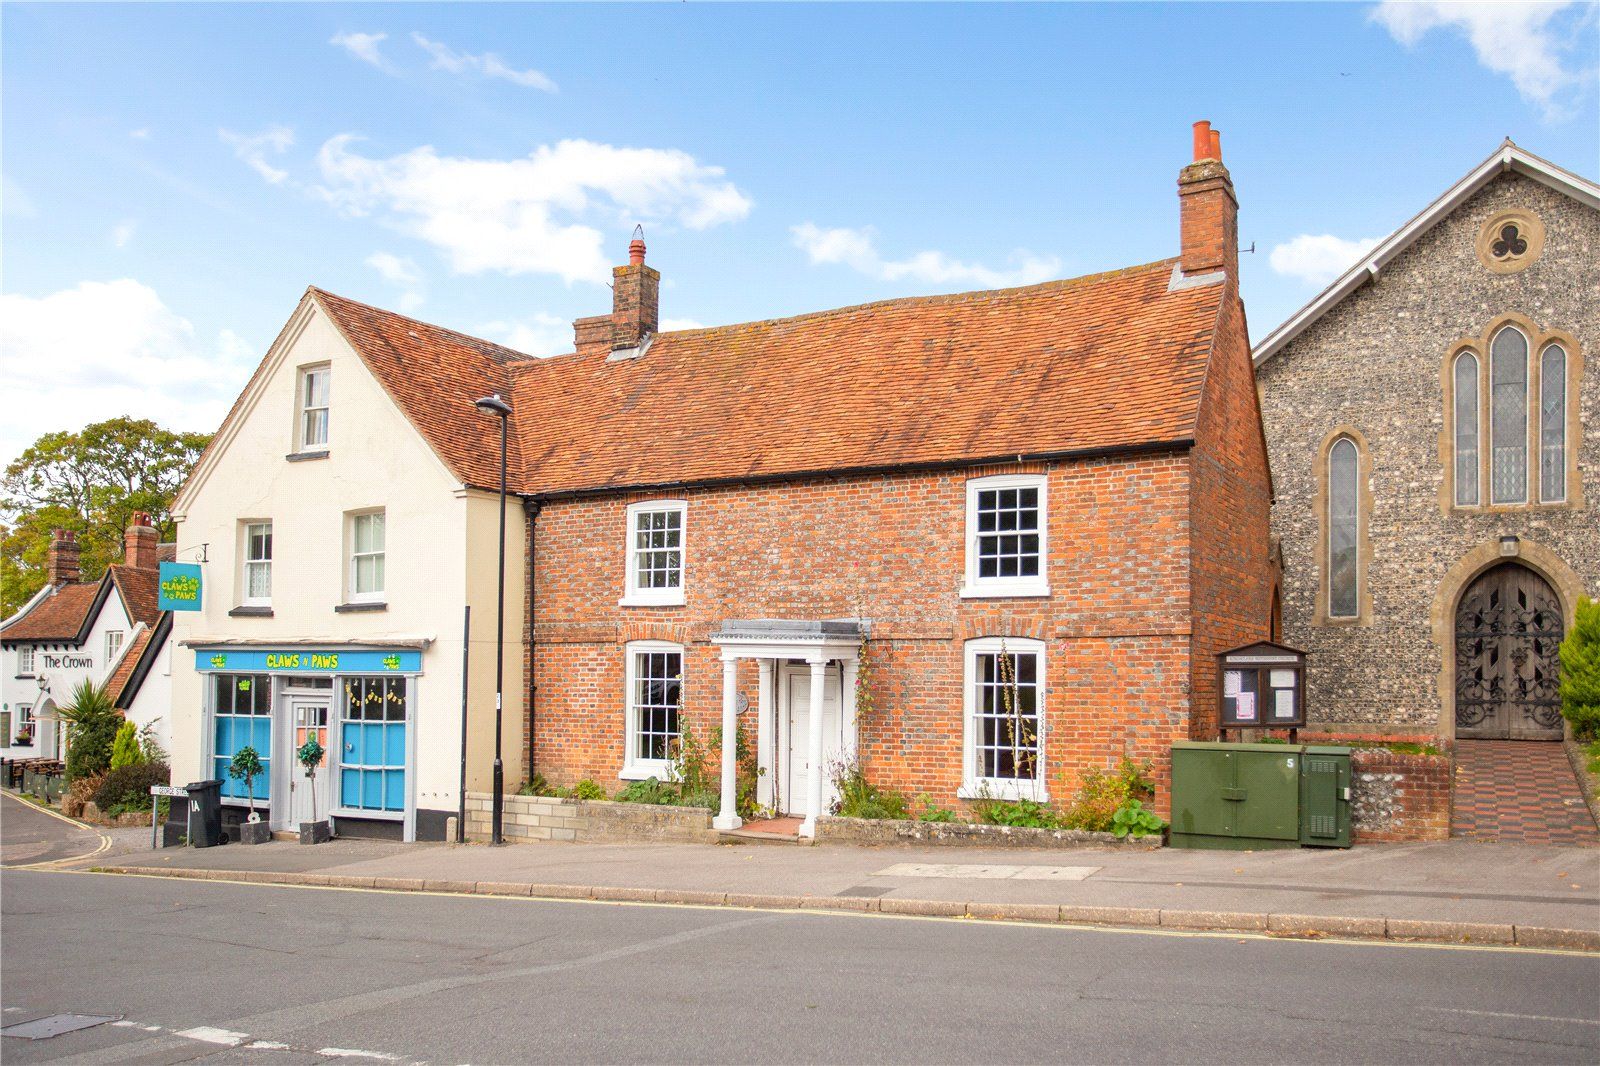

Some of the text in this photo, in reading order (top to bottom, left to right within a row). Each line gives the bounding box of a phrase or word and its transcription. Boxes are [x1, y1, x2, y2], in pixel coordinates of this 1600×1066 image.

[161, 581, 189, 591] CLAWS
[175, 591, 197, 600] PAWS
[43, 655, 93, 668] The Crown
[266, 654, 300, 668] CLAWS
[311, 654, 339, 668] PAWS
[159, 787, 175, 795] GEORGE
